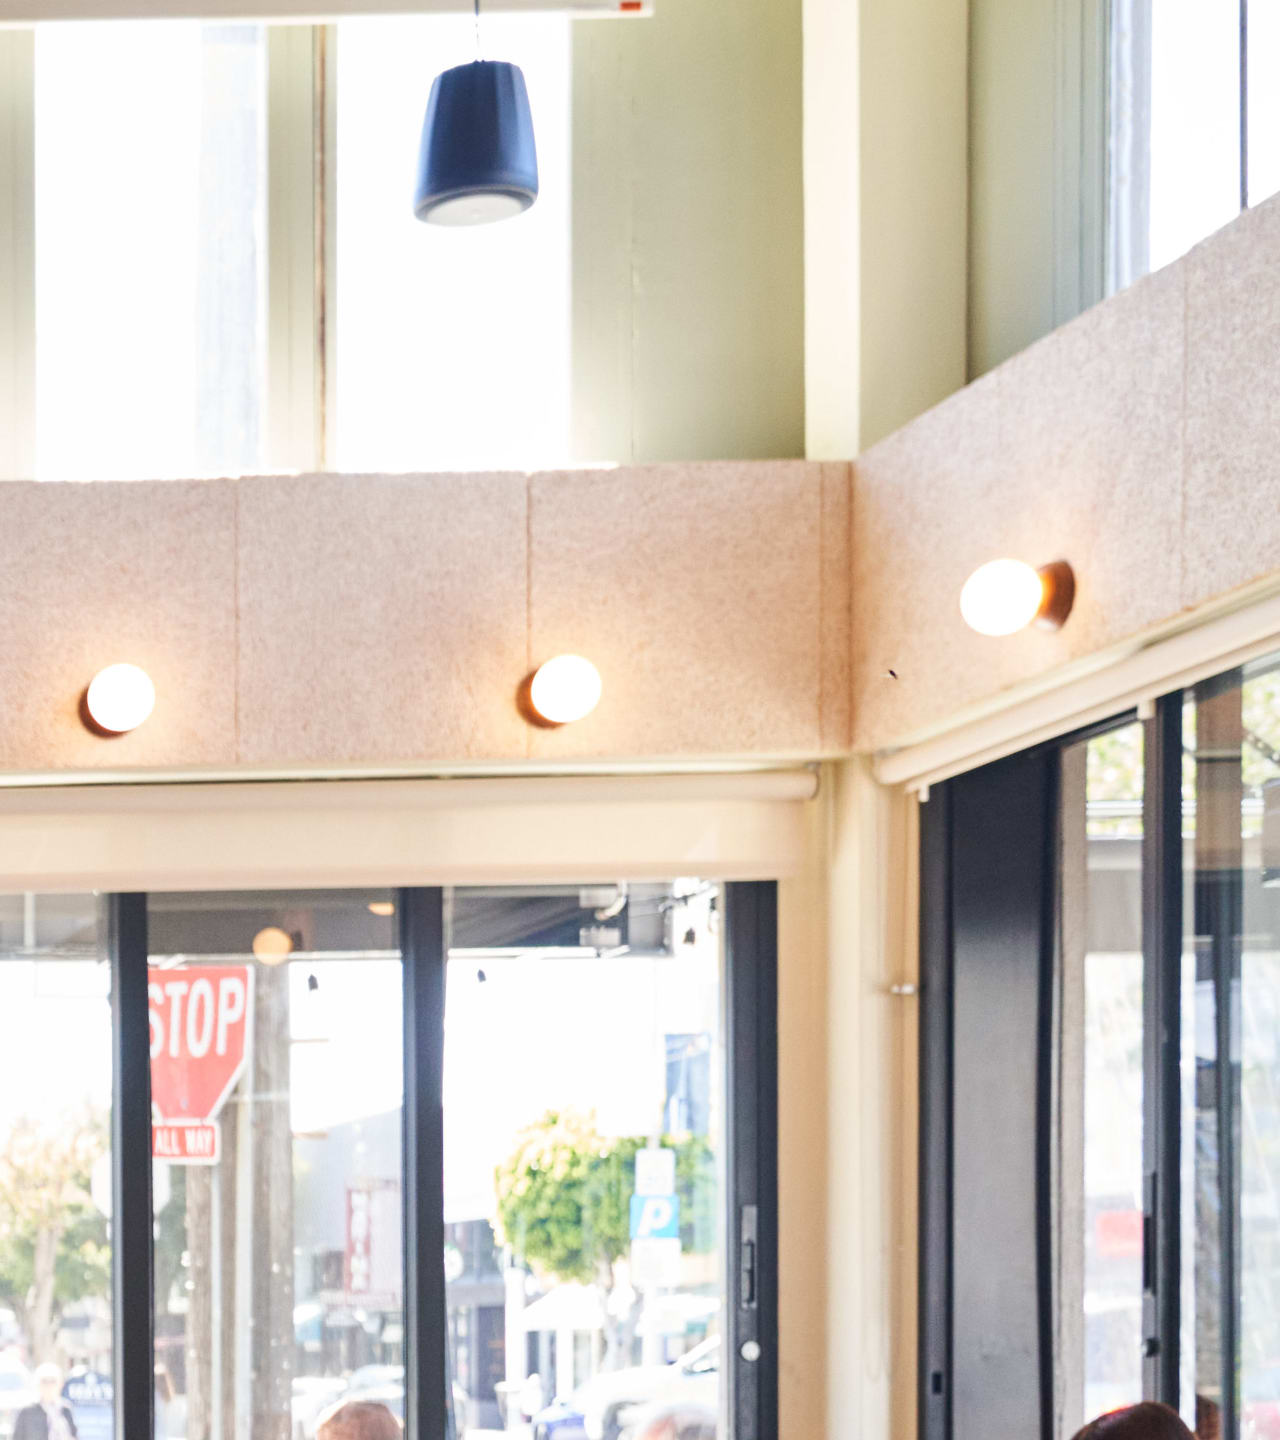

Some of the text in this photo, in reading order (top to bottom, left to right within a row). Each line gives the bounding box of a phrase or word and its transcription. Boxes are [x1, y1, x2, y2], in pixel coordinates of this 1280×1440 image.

[148, 977, 245, 1060] STOP
[154, 1128, 213, 1155] ALL WAY
